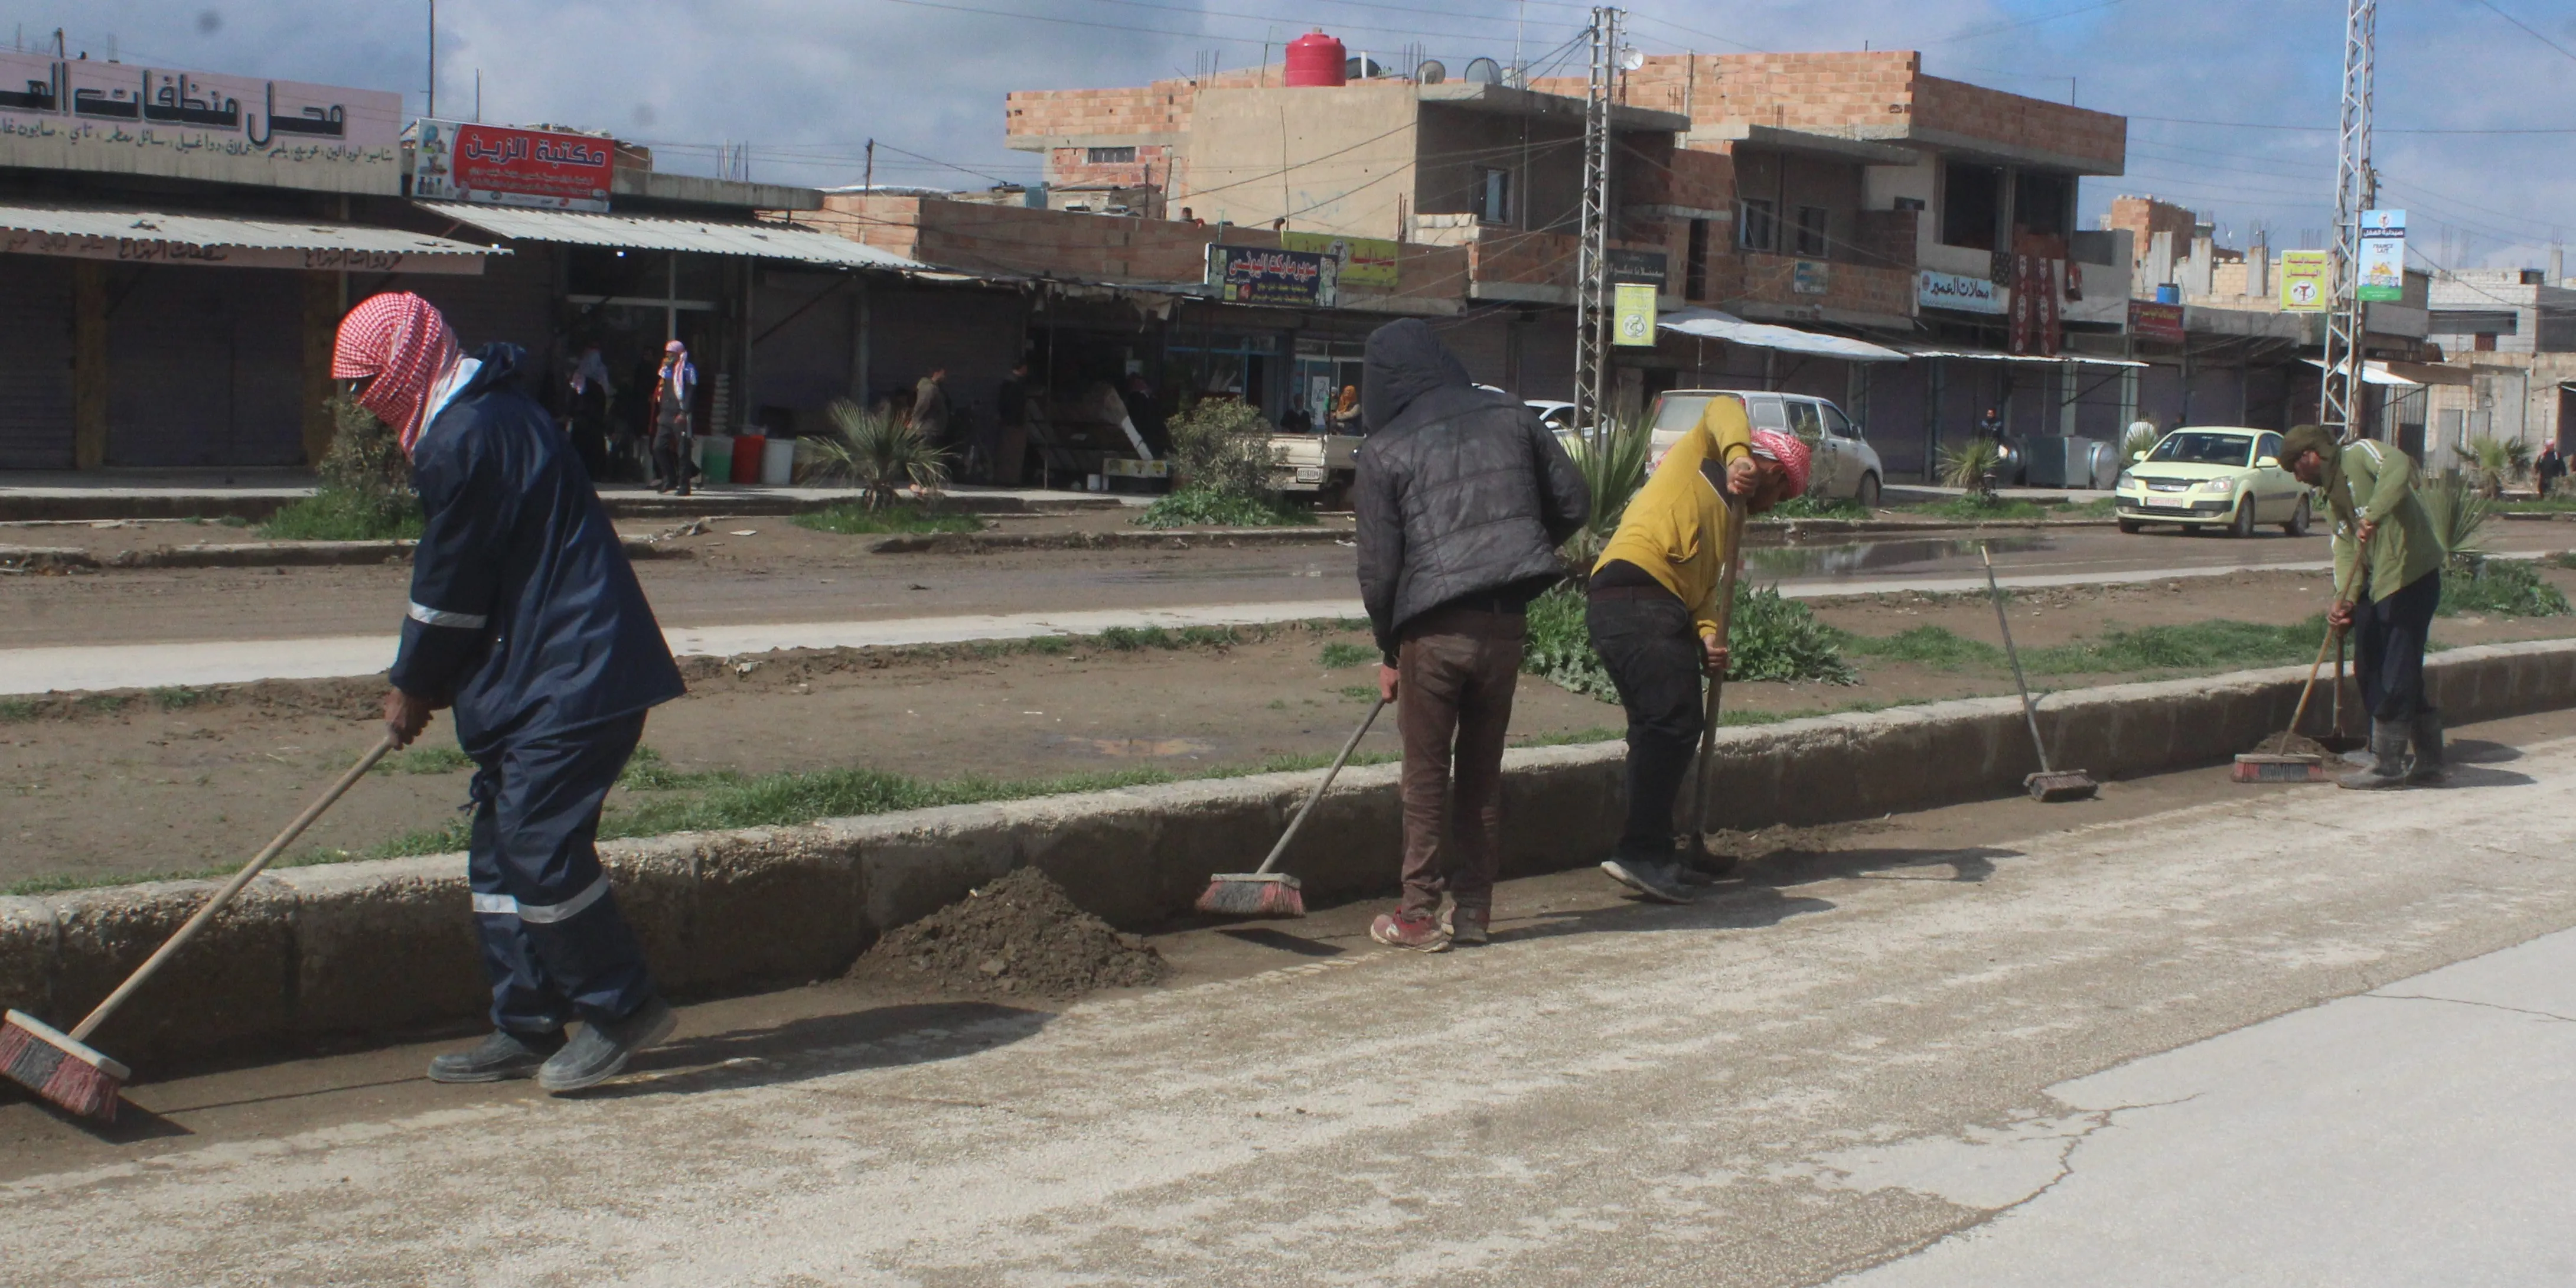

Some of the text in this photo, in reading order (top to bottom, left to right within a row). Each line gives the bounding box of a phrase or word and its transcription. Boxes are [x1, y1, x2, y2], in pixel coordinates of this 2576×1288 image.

[0, 62, 346, 148] محل منظفات اله
[0, 119, 16, 135] غا
[465, 133, 605, 169] مكتبة الزين
